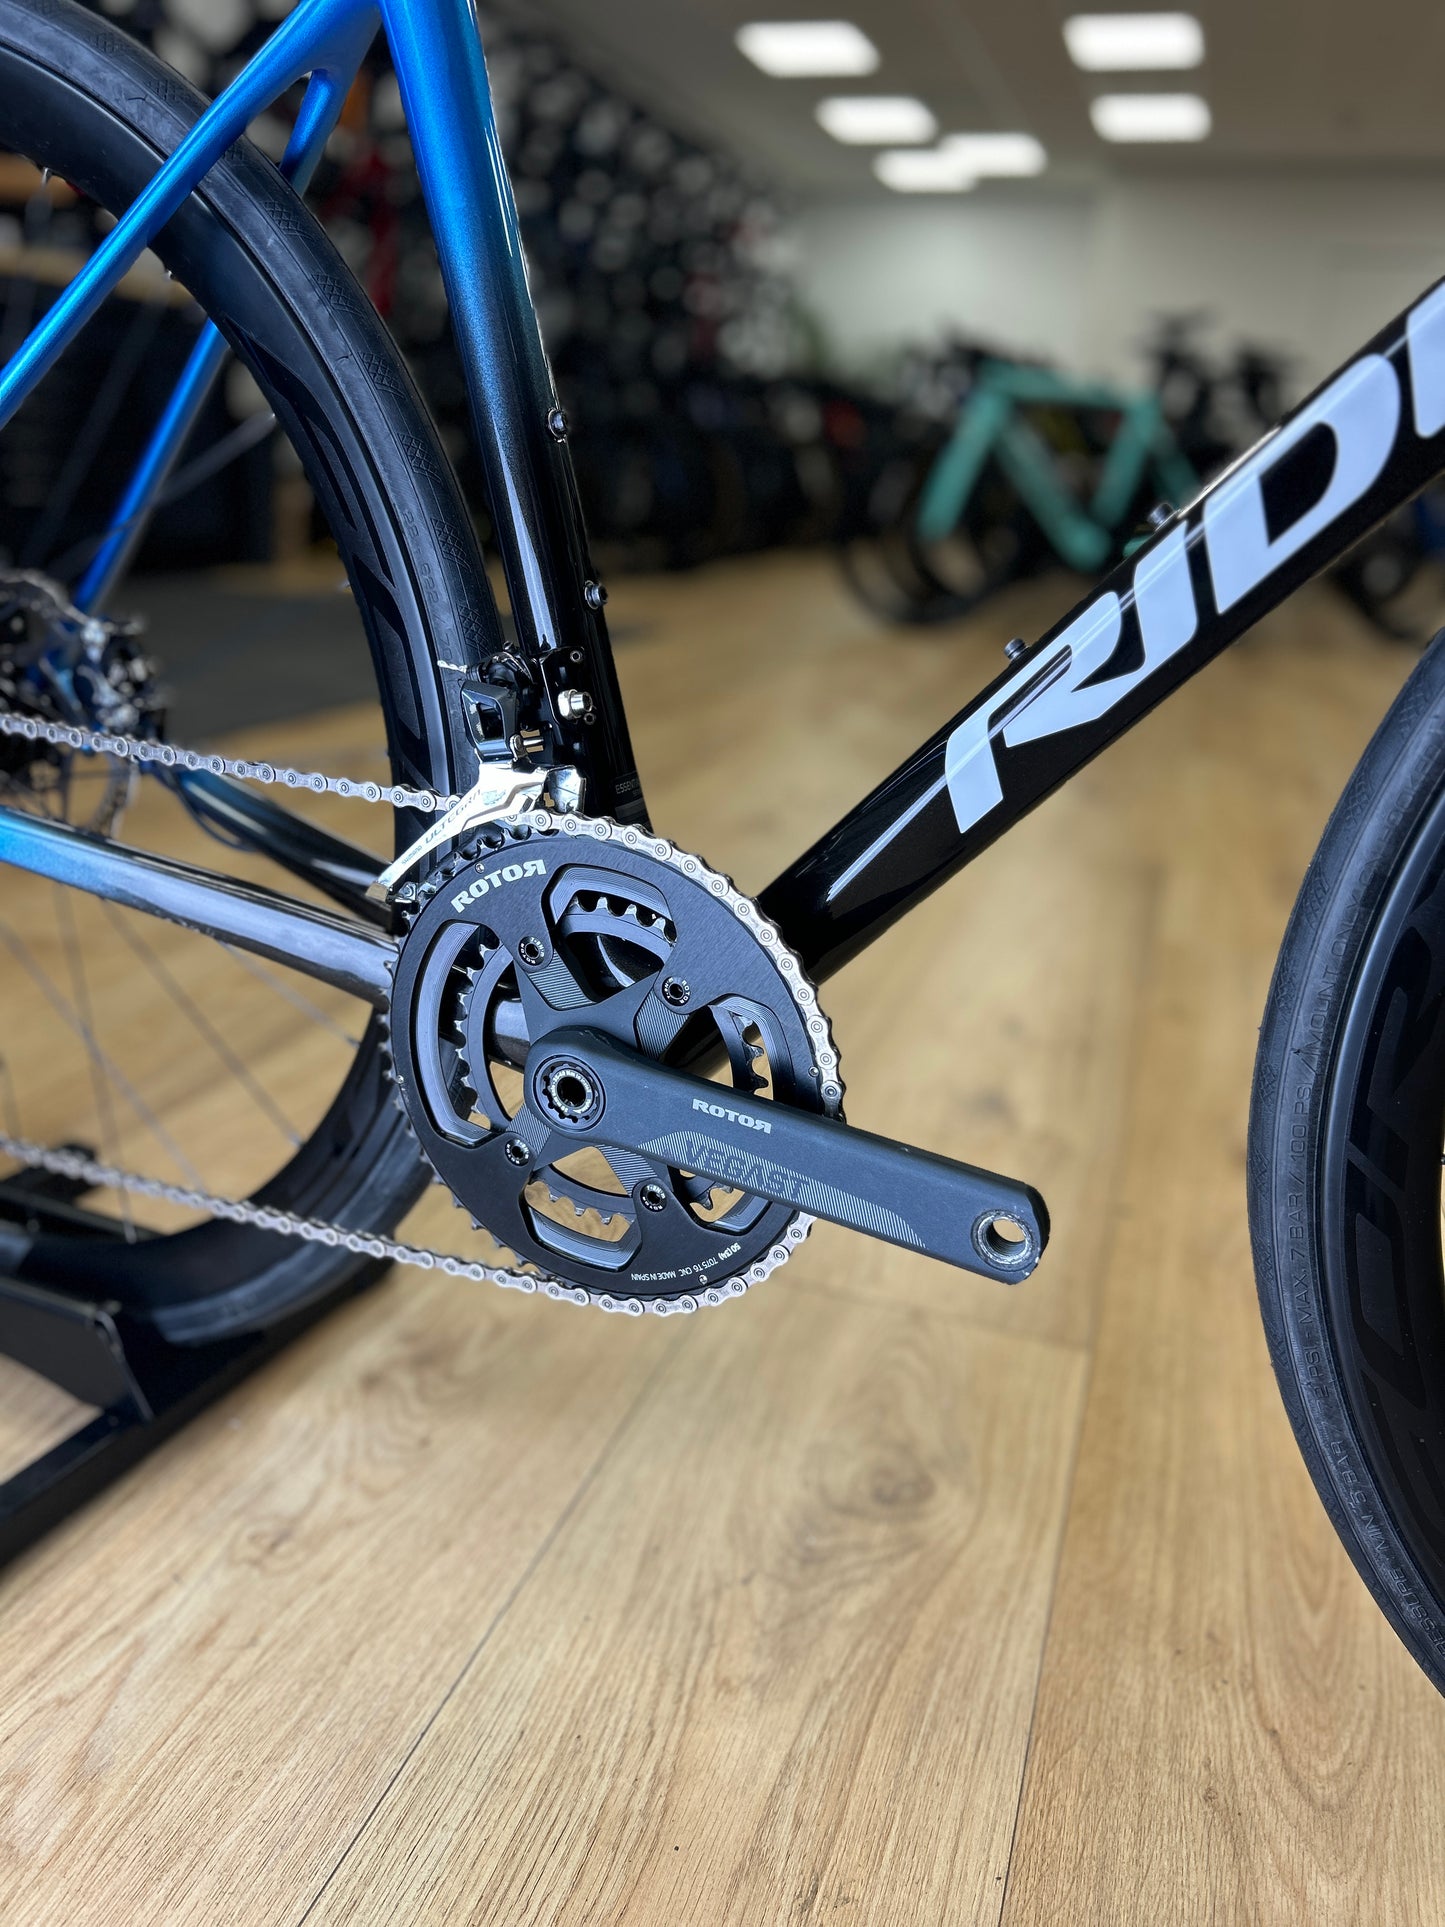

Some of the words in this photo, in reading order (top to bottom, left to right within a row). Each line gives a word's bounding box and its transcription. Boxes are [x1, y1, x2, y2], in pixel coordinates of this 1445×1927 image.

[692, 1098, 772, 1135] ROTOR
[1294, 1081, 1312, 1115] PSI
[1290, 1125, 1307, 1162] 100
[685, 1138, 811, 1202] VEGAST
[1288, 1192, 1304, 1240] BAR
[1289, 1247, 1305, 1260] 7
[658, 1270, 677, 1281] MADE
[1306, 1347, 1324, 1378] PSI
[1329, 1440, 1360, 1485] BAR
